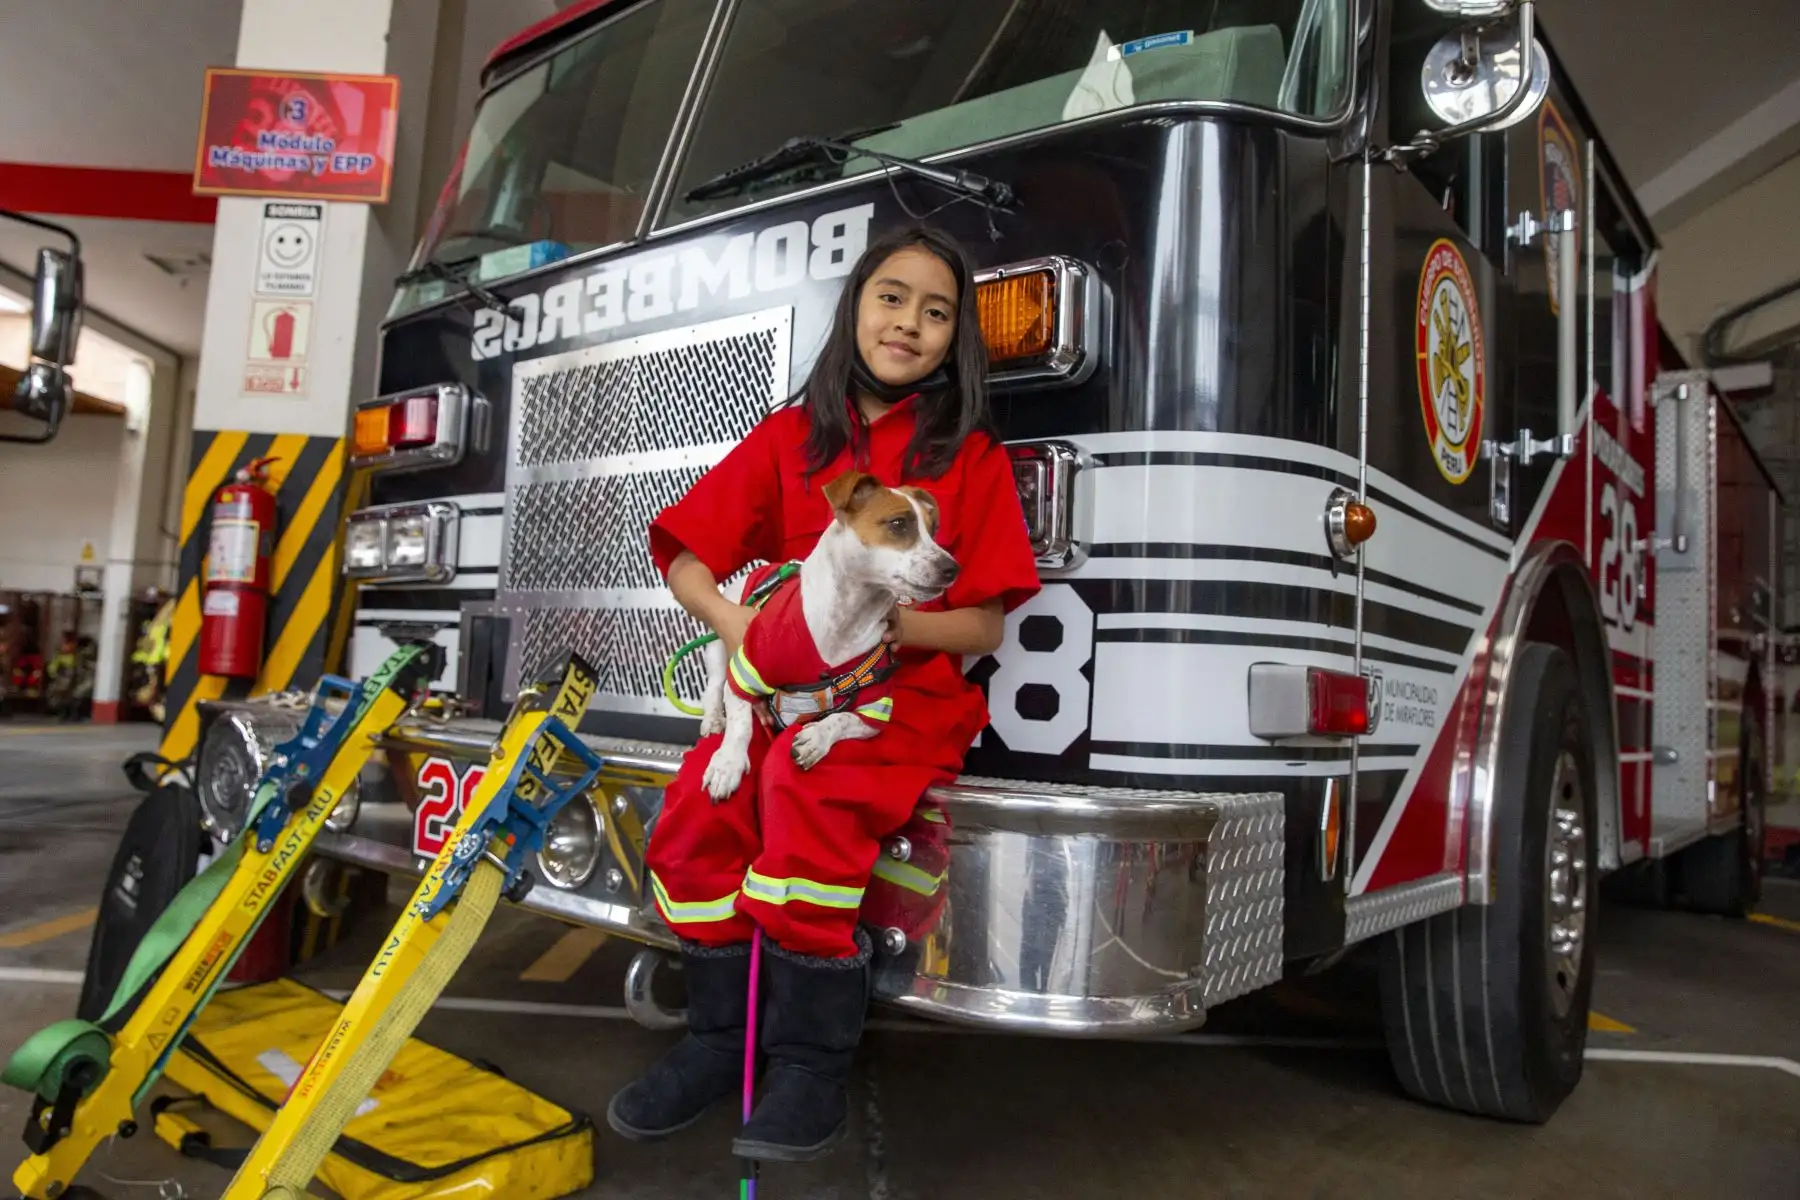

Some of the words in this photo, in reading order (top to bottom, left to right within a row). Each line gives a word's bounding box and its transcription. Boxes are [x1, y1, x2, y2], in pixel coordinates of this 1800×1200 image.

[289, 99, 307, 121] 3
[314, 156, 327, 173] y
[333, 155, 373, 171] EPP
[1601, 482, 1638, 630] 28
[962, 583, 1094, 756] 8
[243, 830, 303, 911] STABFAST
[306, 789, 333, 823] ALU
[373, 937, 400, 977] ALU
